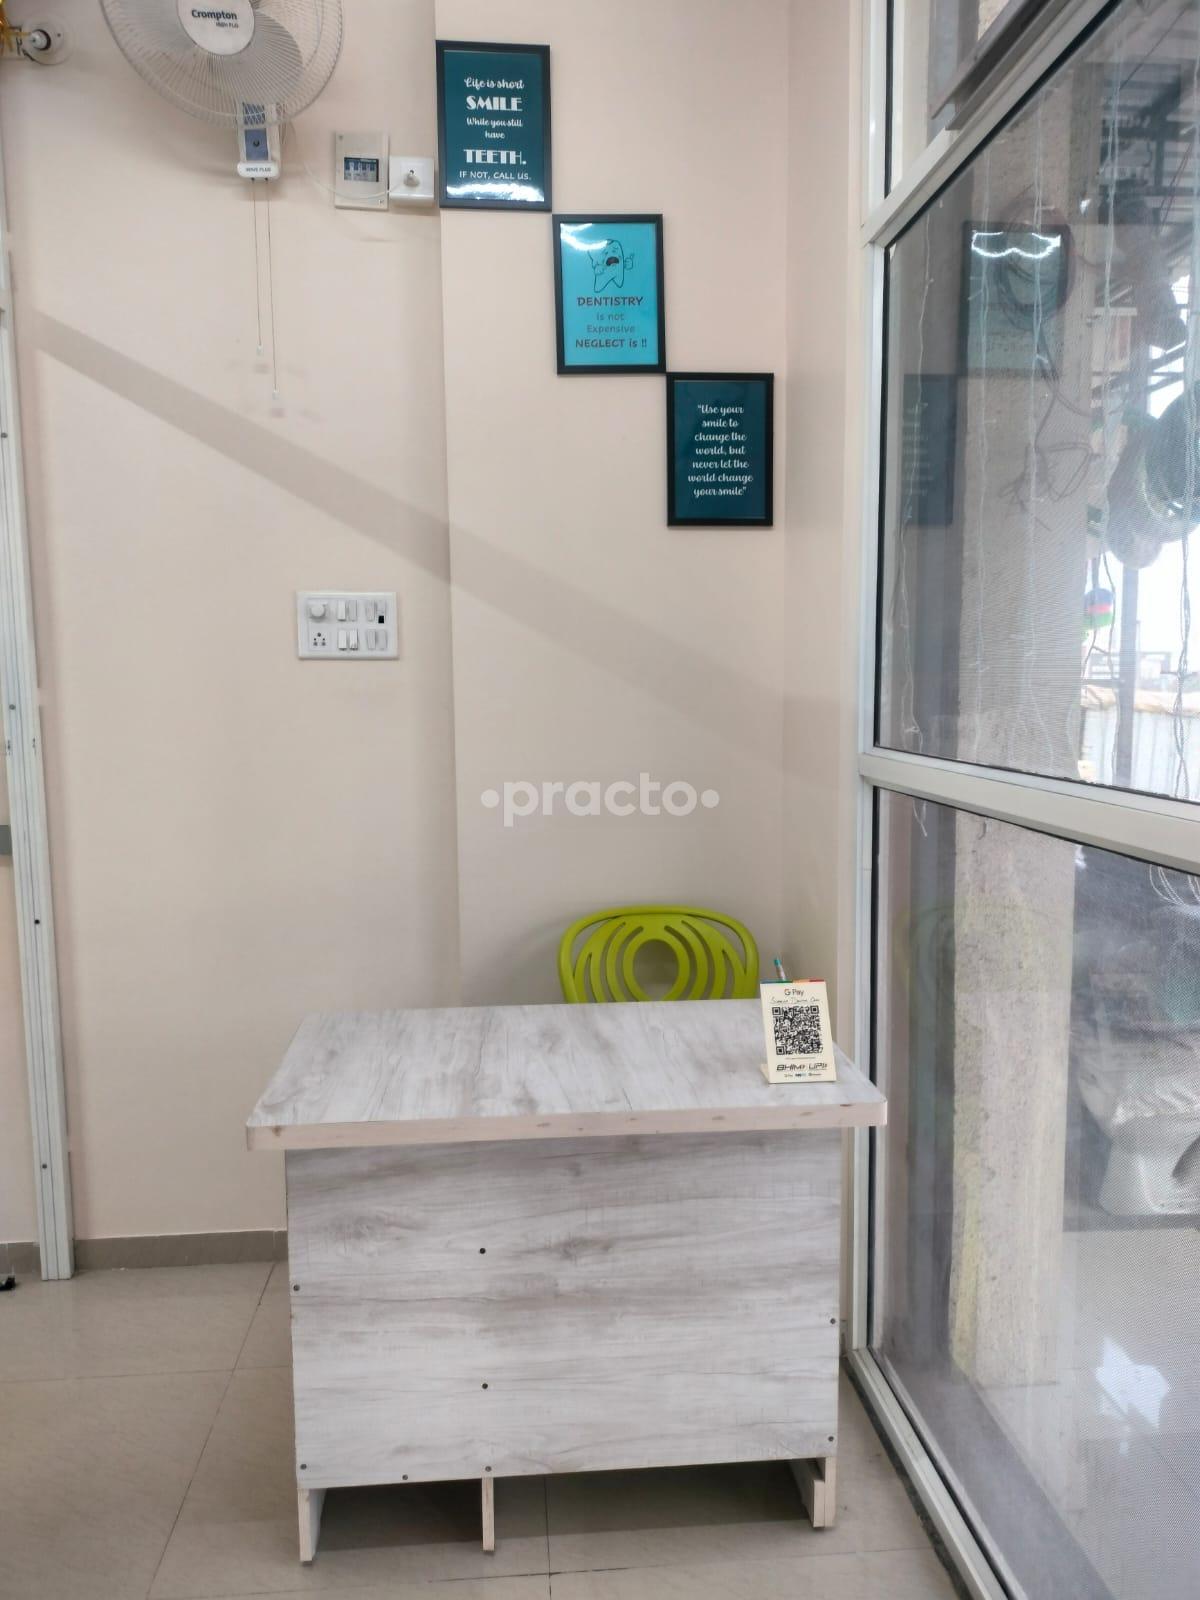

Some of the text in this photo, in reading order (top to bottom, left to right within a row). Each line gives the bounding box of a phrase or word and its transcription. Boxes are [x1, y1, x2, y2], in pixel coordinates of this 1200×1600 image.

[191, 9, 238, 21] Crompton
[464, 77, 525, 90] Life is short
[466, 95, 523, 111] SMILE
[466, 117, 523, 128] While you still
[485, 130, 505, 139] have
[463, 149, 527, 165] TEETH.
[459, 170, 532, 180] IF NOT, CALL US.
[577, 296, 643, 306] DENTISTRY
[596, 313, 624, 321] is not
[586, 324, 635, 335] Expensive
[575, 338, 647, 348] NEGLECT is !!
[697, 404, 744, 417] "Use your
[702, 418, 739, 428] smile to
[694, 432, 747, 443] change the
[695, 446, 746, 456] world, but
[692, 459, 749, 469] never let the
[688, 473, 754, 485] world change
[693, 486, 747, 498] your smile"
[791, 988, 804, 997] Pay
